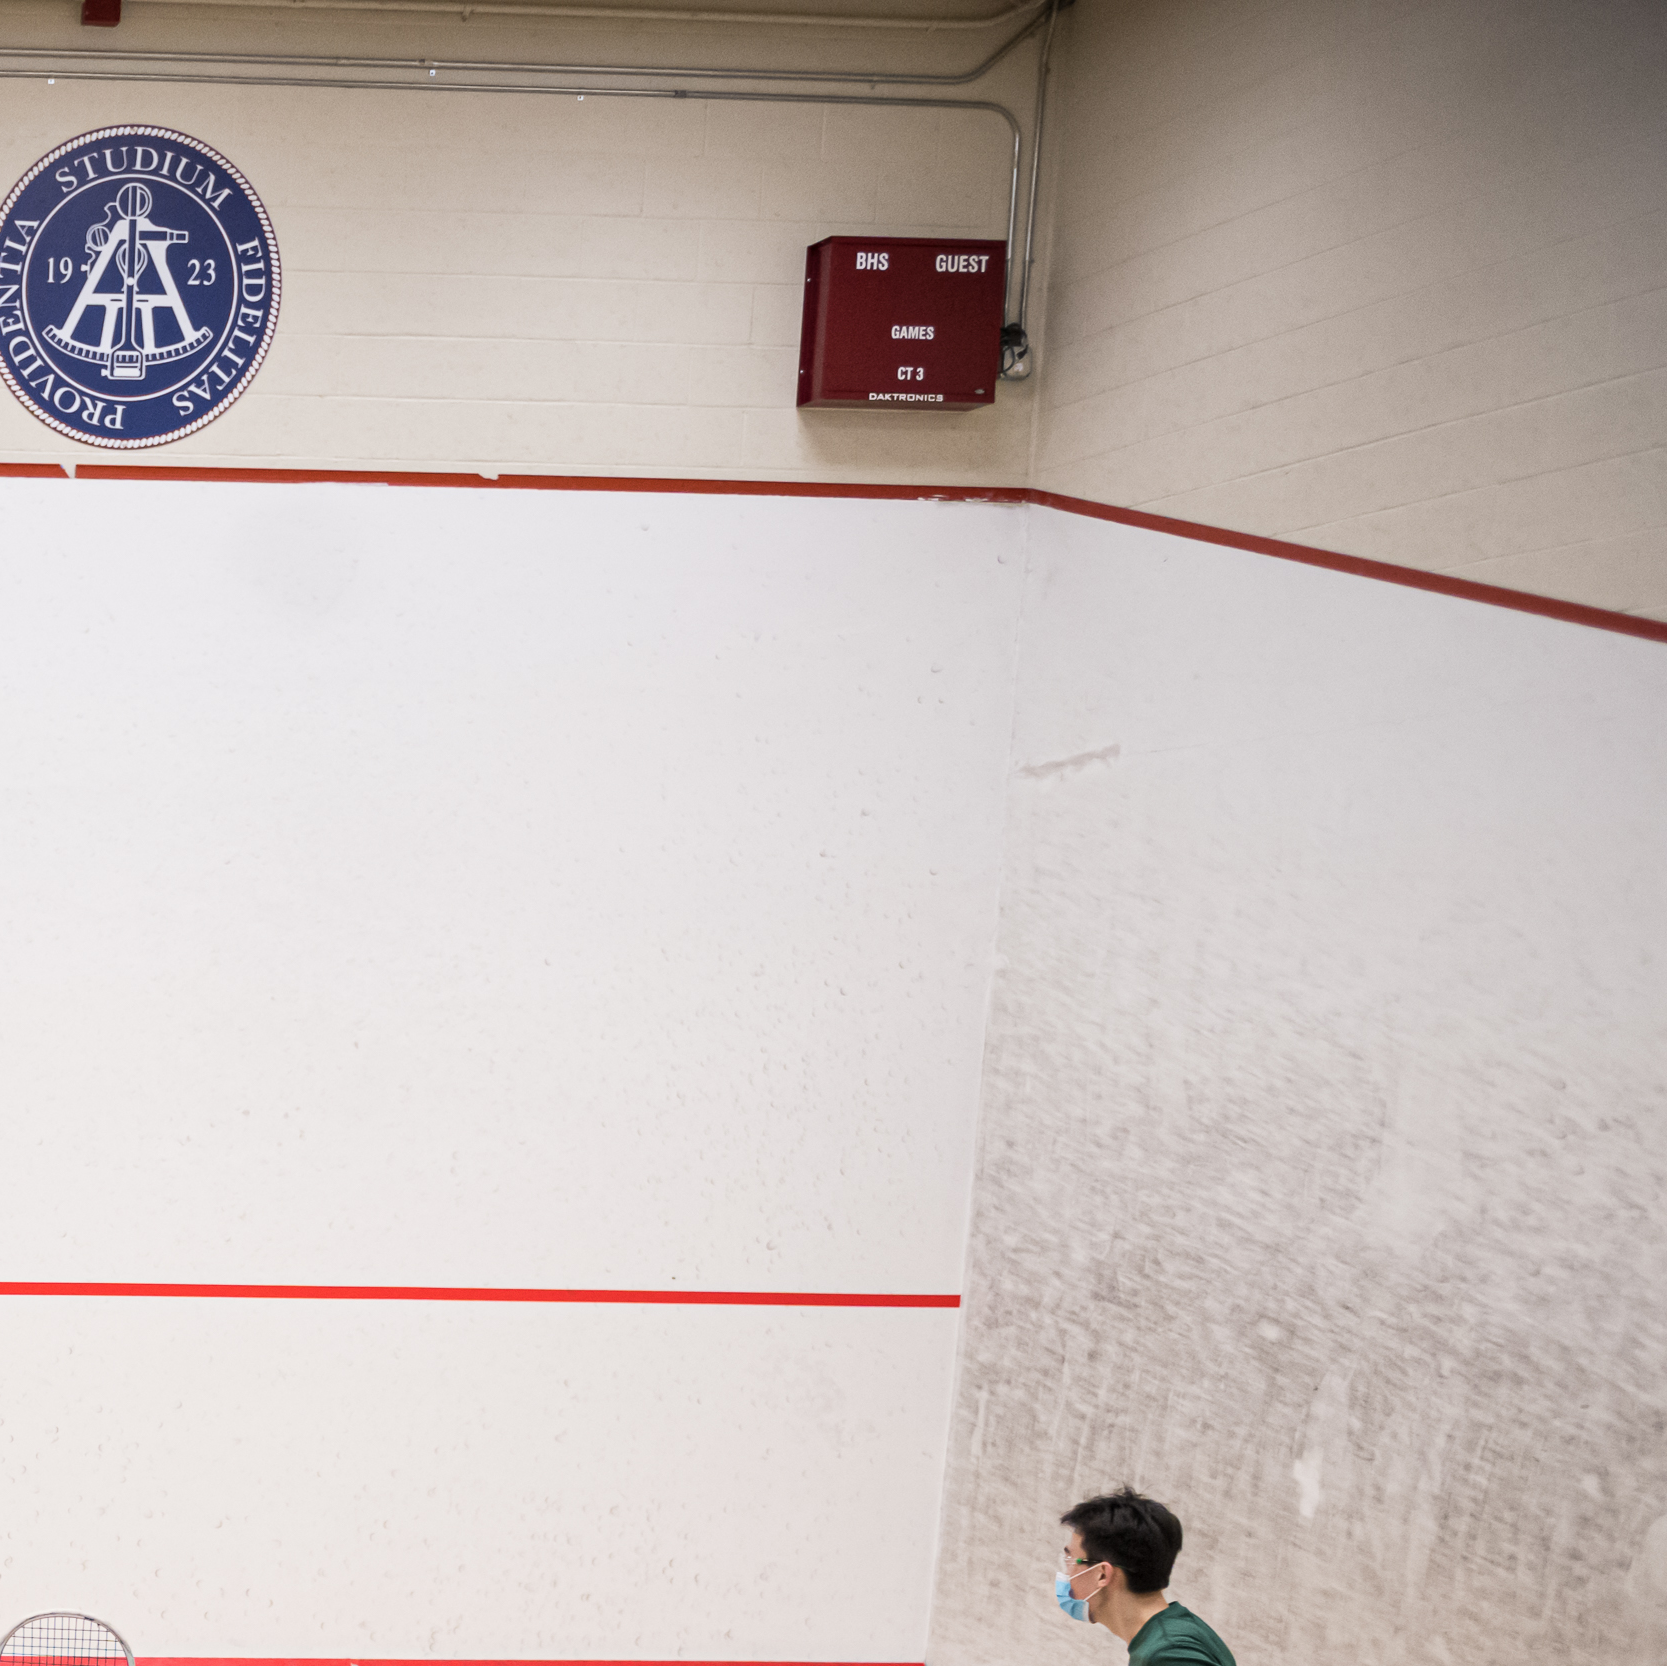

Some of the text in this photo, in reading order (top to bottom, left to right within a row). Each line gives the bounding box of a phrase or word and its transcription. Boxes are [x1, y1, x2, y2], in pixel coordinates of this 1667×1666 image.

[47, 256, 216, 286] 19 23
[856, 252, 989, 273] BHS GUEST
[55, 146, 233, 211] STUDIUM
[173, 237, 266, 416] FIDELITAS
[891, 325, 935, 341] GAMES
[897, 366, 924, 381] CT 3
[869, 392, 944, 402] DAKTRONICS
